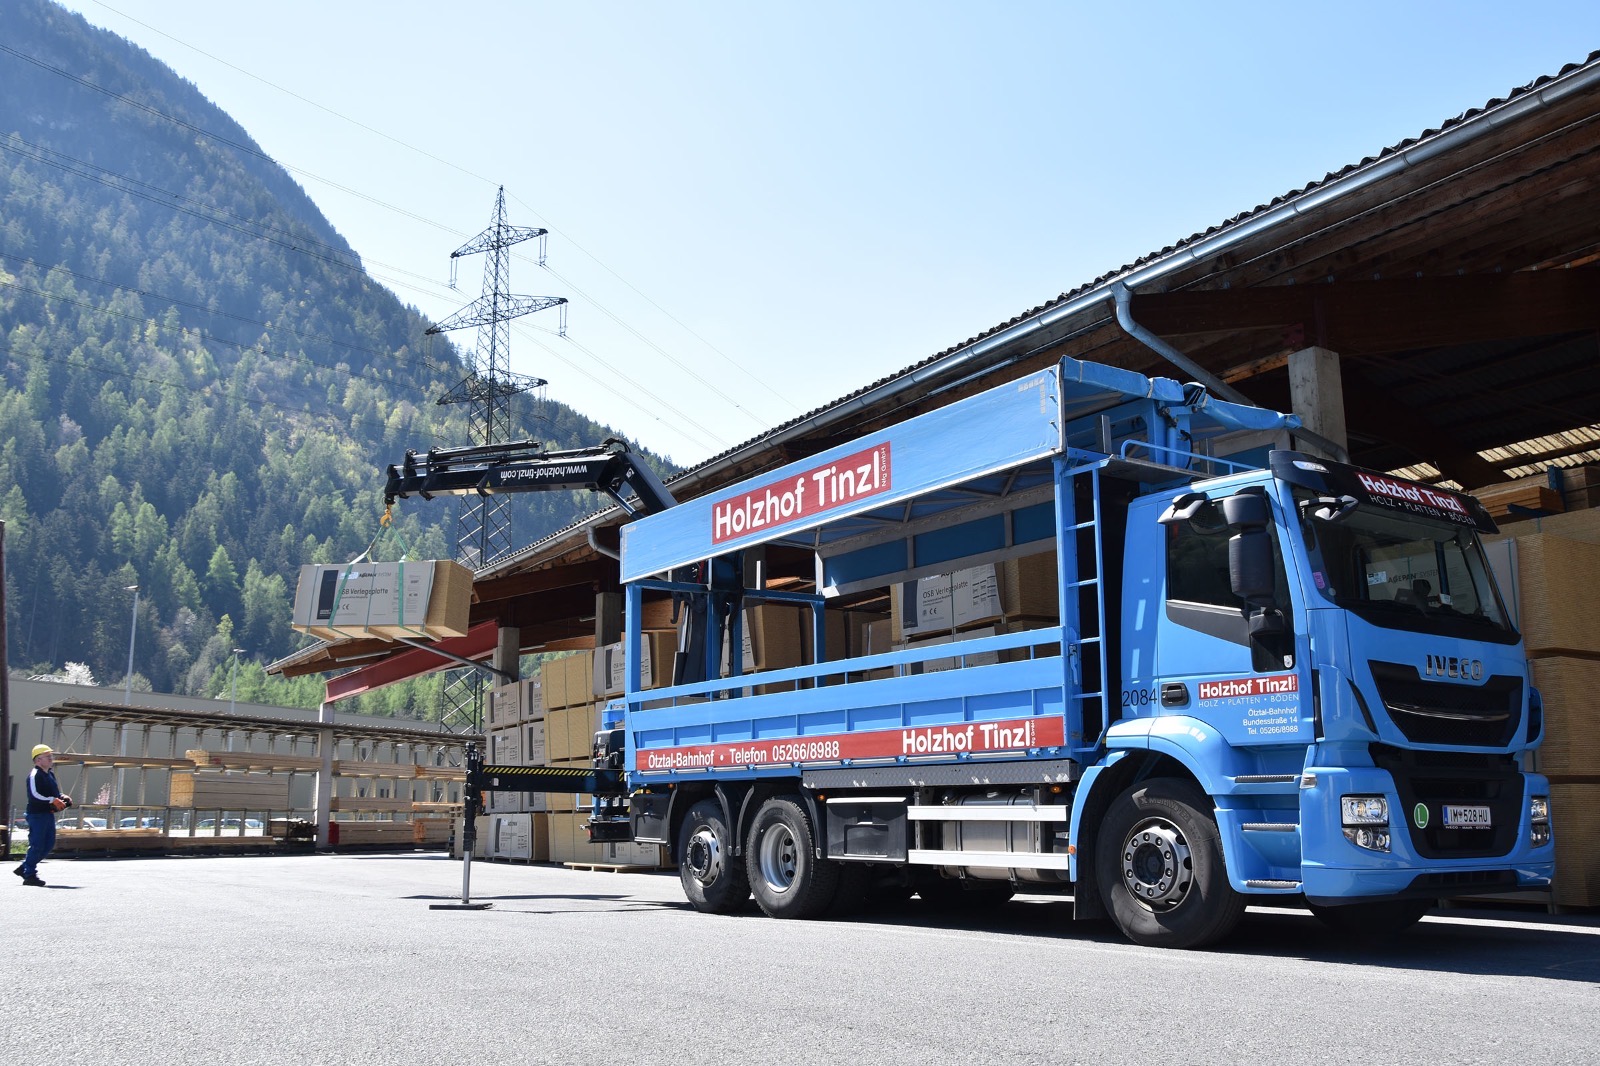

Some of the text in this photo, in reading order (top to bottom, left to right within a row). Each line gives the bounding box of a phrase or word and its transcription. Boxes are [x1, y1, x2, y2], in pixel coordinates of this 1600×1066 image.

[500, 464, 588, 480] www.holzhof-tinzl.com
[715, 450, 880, 540] Holzhof Tinzl
[1358, 474, 1463, 513] Holzhof Tinzl
[1368, 494, 1396, 507] HOLZ
[1403, 501, 1441, 517] PLATTEN
[1388, 572, 1417, 584] AGEPAN
[1419, 569, 1438, 578] SYSTE
[922, 589, 935, 599] OSB
[1426, 654, 1484, 681] IVECO
[1200, 679, 1253, 698] Holzhof
[1256, 676, 1292, 693] Tinzl
[1122, 687, 1158, 707] 2084
[1198, 693, 1300, 708] HOLZ PLATTEN BÖDEN
[1247, 706, 1298, 717] Ötztal-Bahnhof
[1242, 716, 1298, 726] Bundesstraße 14
[902, 720, 1030, 754] Holzhof Tinzl
[1247, 725, 1299, 735] Tel. 05266/8988
[648, 740, 840, 769] Ötztal-Bahnhof Telefon 05266/8988
[1417, 807, 1425, 824] L
[1449, 809, 1488, 823] IM 528 HU
